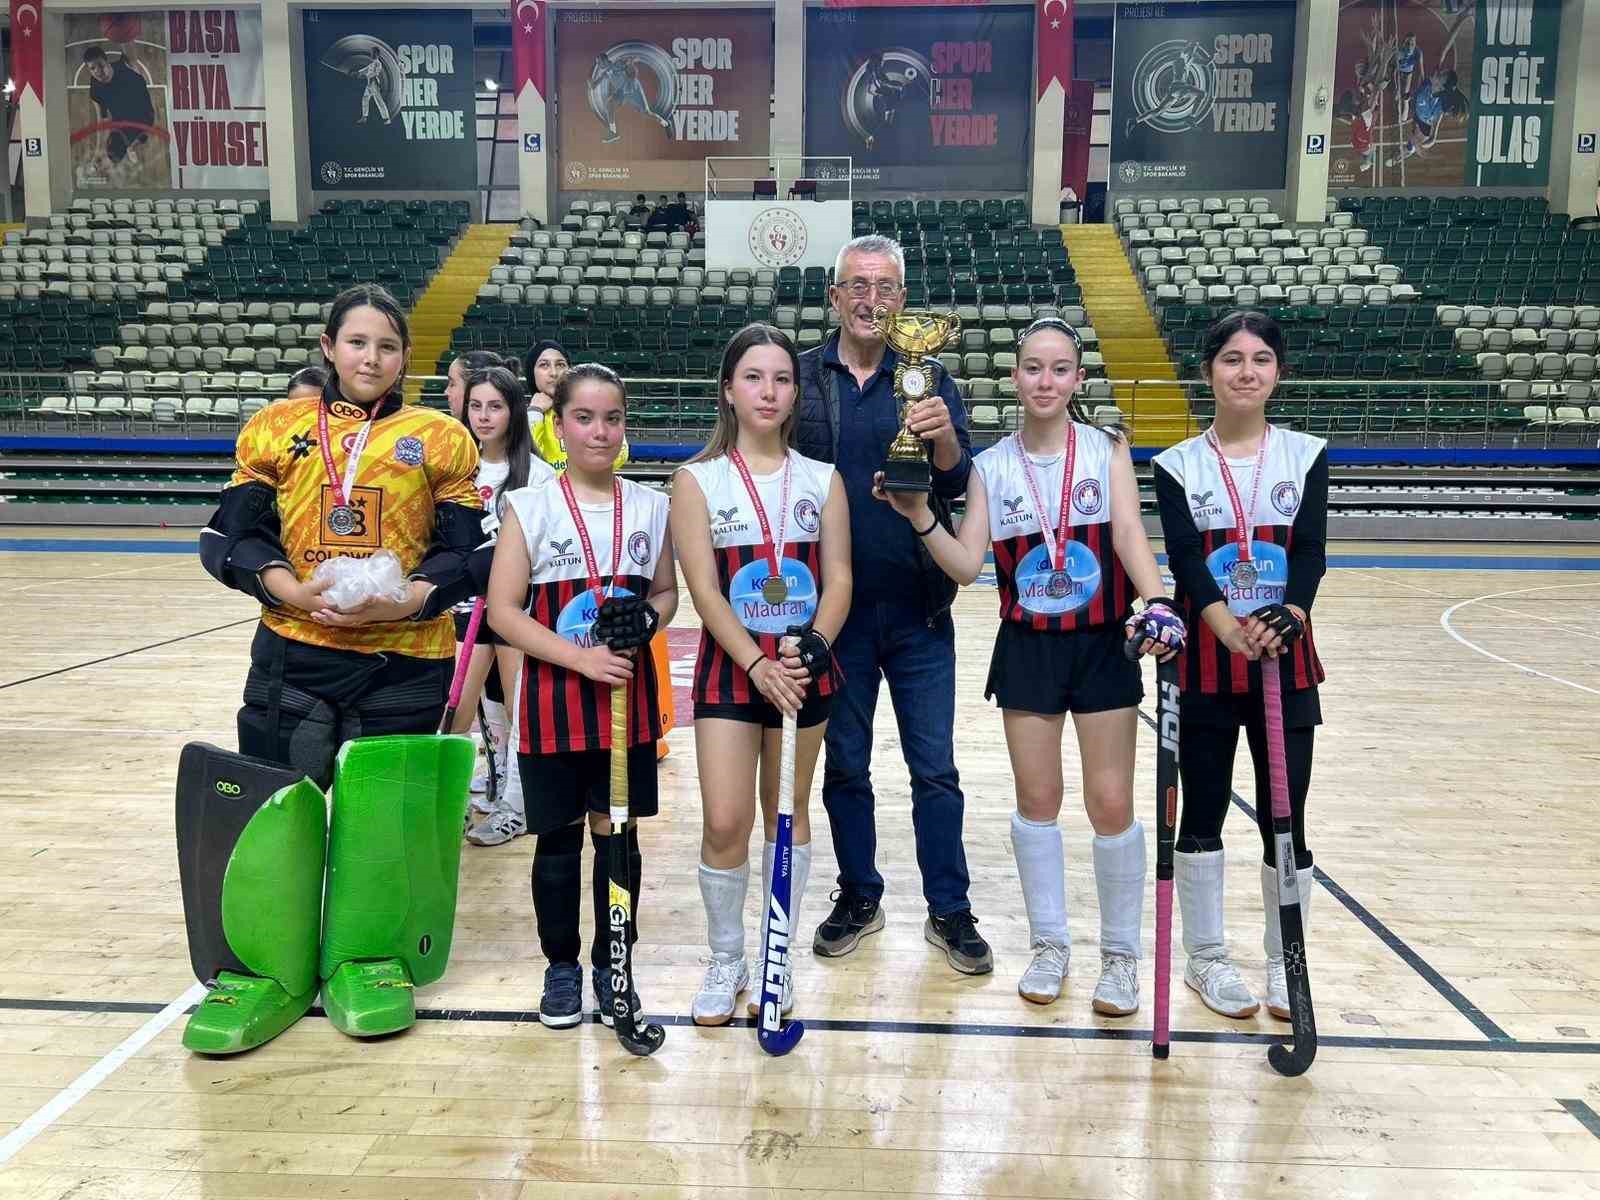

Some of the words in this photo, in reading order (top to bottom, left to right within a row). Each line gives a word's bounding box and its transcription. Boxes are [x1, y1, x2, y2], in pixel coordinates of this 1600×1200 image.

[169, 10, 240, 58] BAŞA
[1214, 34, 1273, 64] SPOR
[397, 44, 455, 74] SPOR
[671, 38, 732, 70] SPOR
[931, 42, 992, 73] SPOR
[171, 65, 231, 110] RIYA
[400, 78, 439, 107] HER
[672, 74, 713, 105] HER
[930, 78, 973, 110] HER
[1214, 68, 1253, 98] HER
[401, 110, 465, 140] YERDE
[672, 110, 739, 141] YERDE
[929, 114, 998, 146] YERDE
[1213, 102, 1277, 132] YERDE
[28, 139, 38, 150] B
[527, 134, 538, 146] C
[1310, 135, 1322, 148] D
[1476, 116, 1541, 168] ULAŞ
[1581, 134, 1593, 147] D
[1193, 506, 1222, 519] ALTUN
[743, 599, 809, 619] Madran
